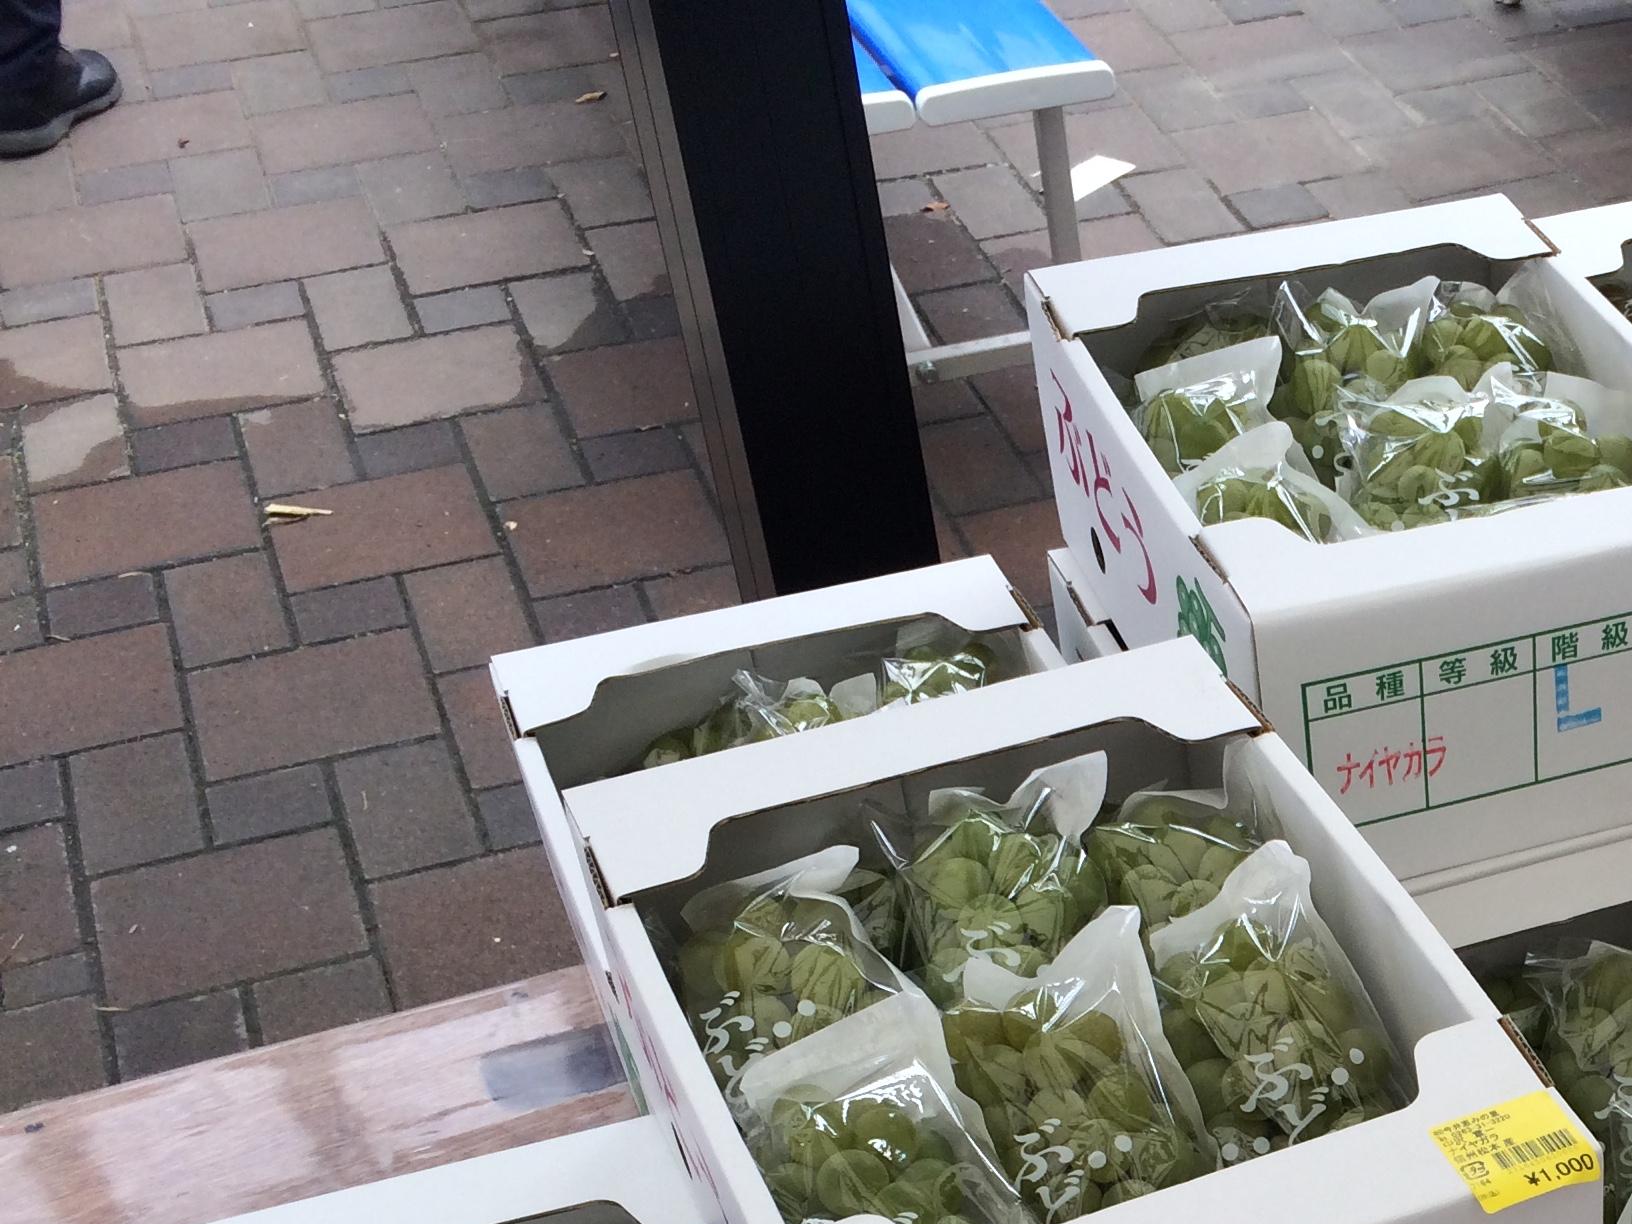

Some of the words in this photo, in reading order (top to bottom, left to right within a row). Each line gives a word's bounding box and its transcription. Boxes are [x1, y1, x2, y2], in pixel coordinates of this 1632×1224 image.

[1050, 368, 1159, 606] ぶどう
[1551, 622, 1629, 661] 階級
[1438, 645, 1519, 685] 等級
[1323, 671, 1407, 711] 品種
[1555, 663, 1602, 733] L
[1336, 735, 1448, 796] ナイヤガラ
[1523, 1153, 1594, 1186] ¥1,000
